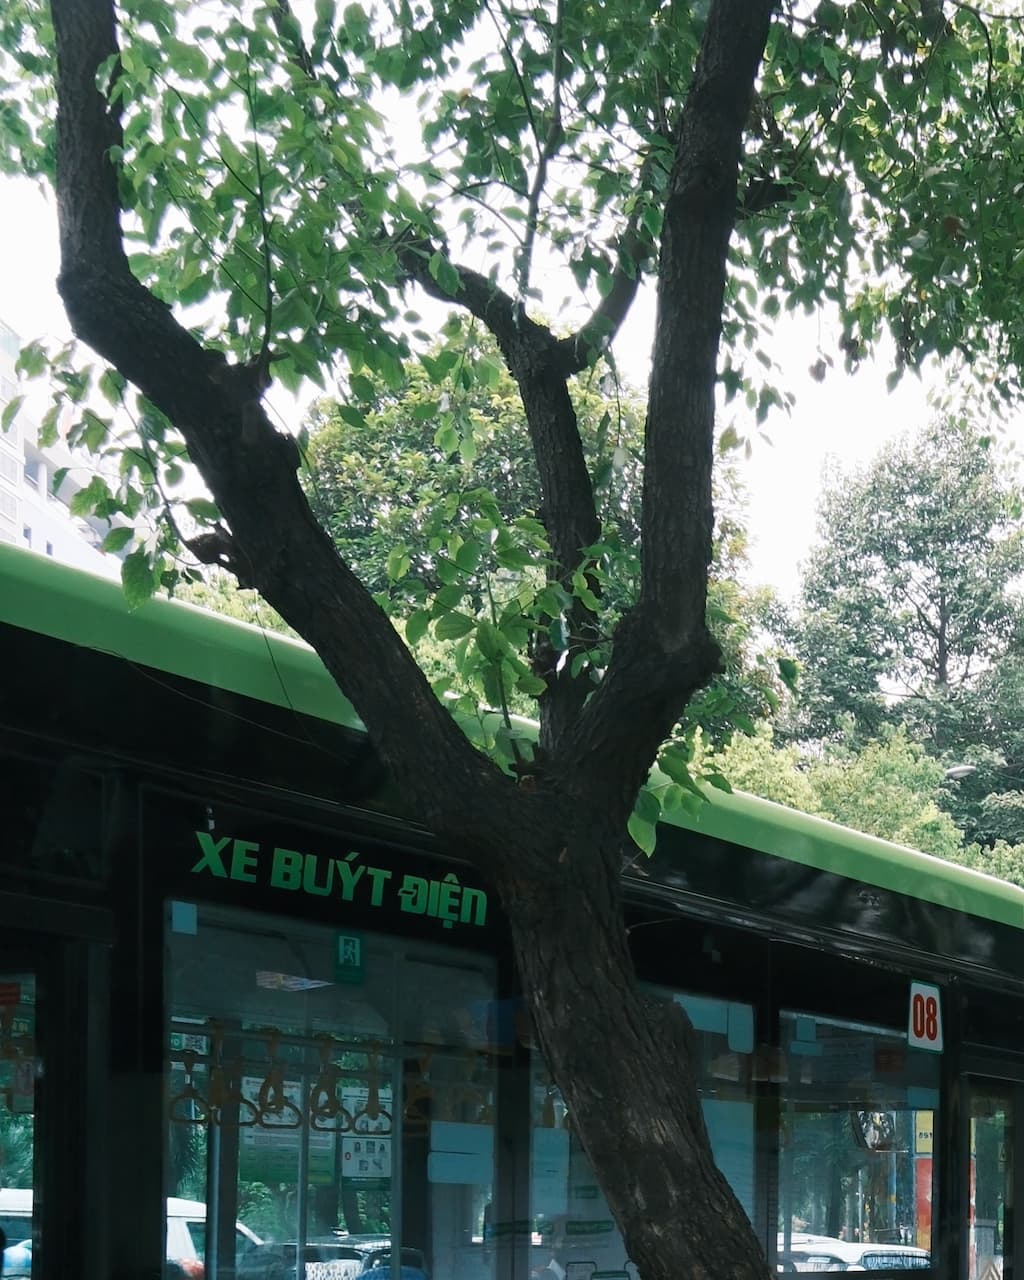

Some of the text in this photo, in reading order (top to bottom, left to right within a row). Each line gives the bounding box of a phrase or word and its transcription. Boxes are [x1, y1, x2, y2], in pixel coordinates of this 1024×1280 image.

[191, 831, 487, 929] XE BUÝT ĐIỆN
